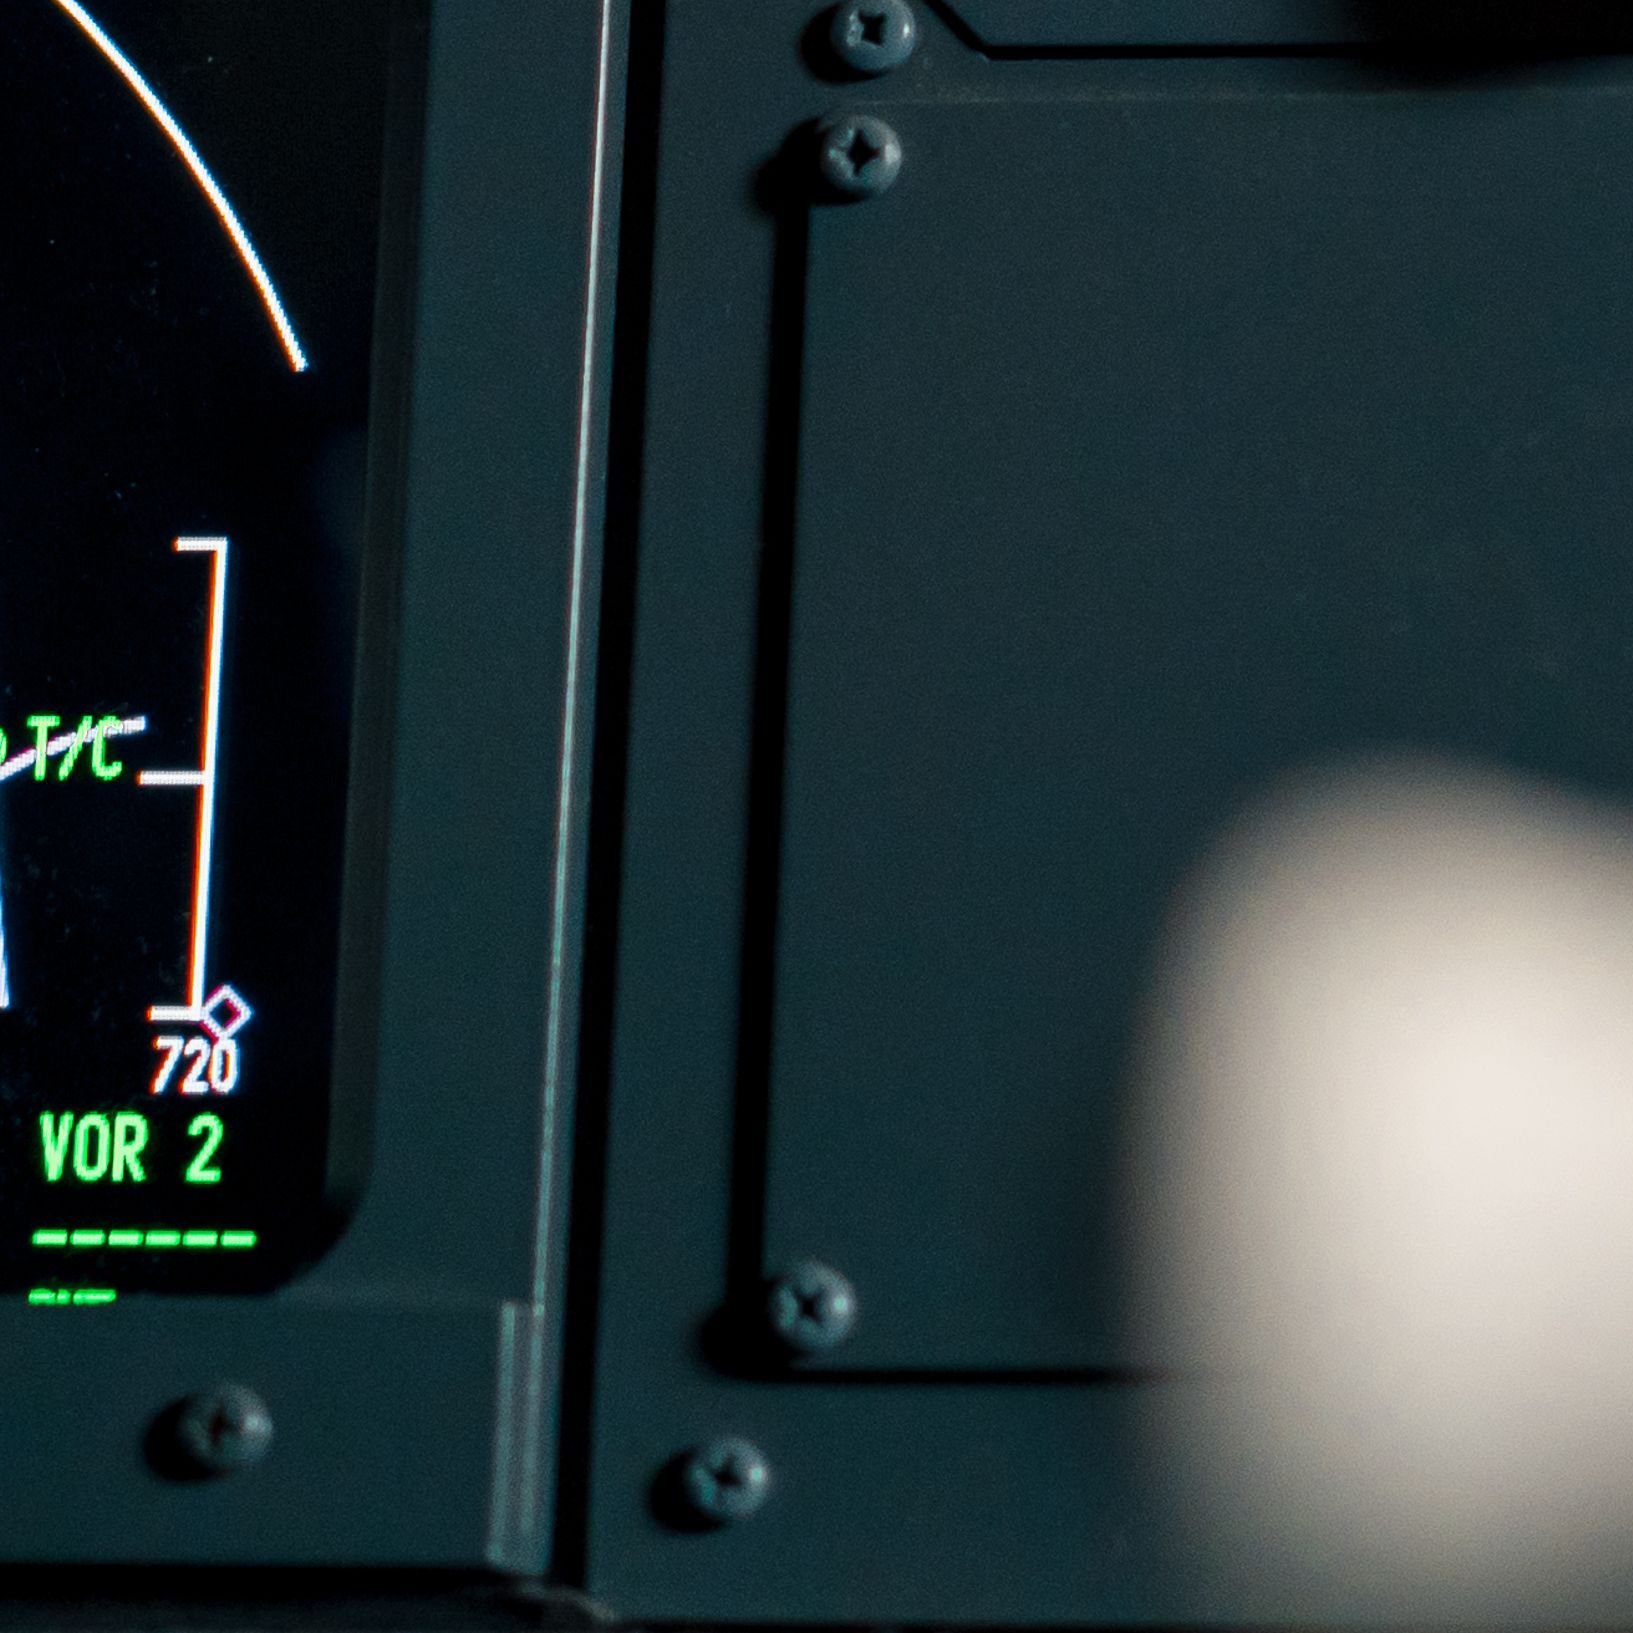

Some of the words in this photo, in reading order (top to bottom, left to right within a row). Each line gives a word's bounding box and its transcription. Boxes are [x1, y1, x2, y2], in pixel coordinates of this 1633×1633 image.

[27, 715, 123, 781] T/C
[151, 1036, 239, 1094] 720
[39, 1111, 149, 1183] VOR
[185, 1111, 224, 1184] 2
